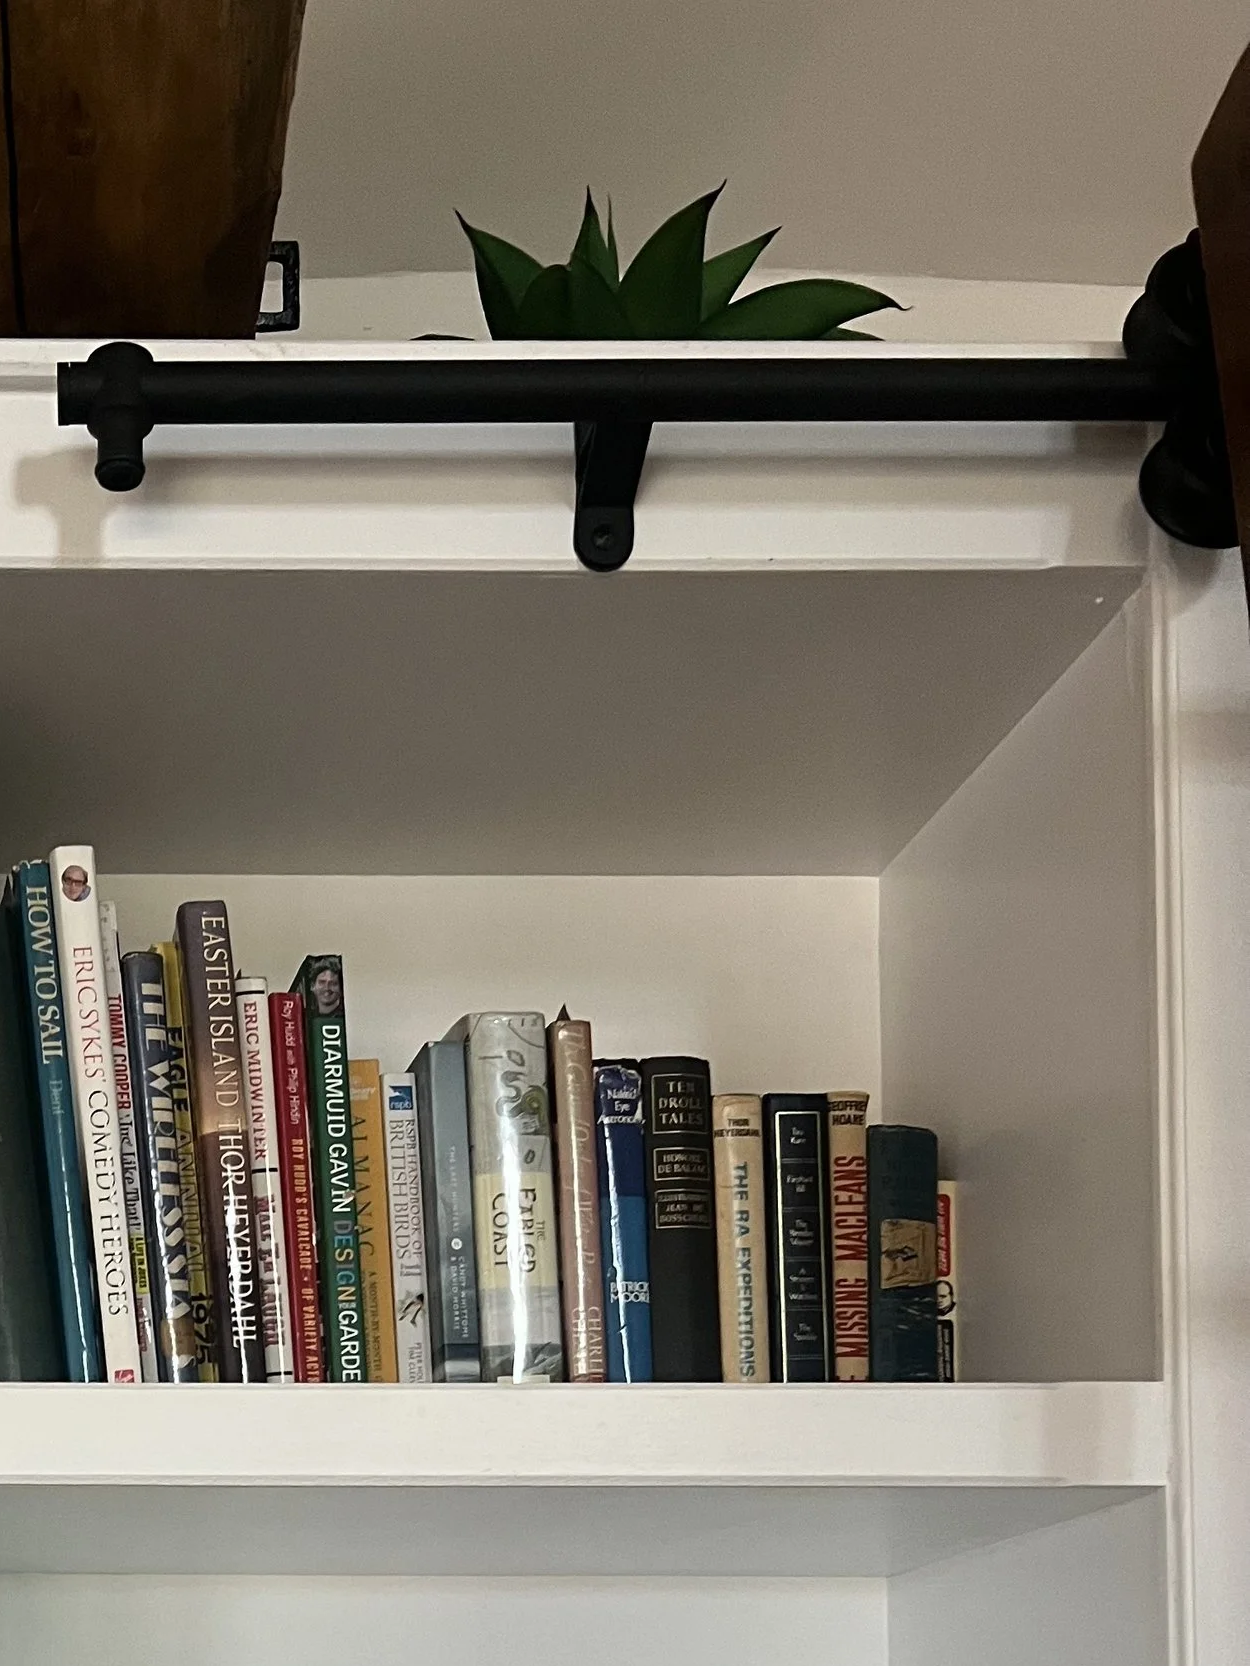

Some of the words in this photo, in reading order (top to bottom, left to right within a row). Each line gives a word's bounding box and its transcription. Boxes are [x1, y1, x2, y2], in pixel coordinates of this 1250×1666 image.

[25, 885, 54, 956] HOW
[33, 960, 58, 1001] TO
[73, 945, 97, 1005] ERIC
[200, 916, 232, 1010] EASTER
[37, 1004, 64, 1065] SAIL
[107, 993, 128, 1049] TOMMY
[141, 982, 168, 1051] THE
[243, 1001, 260, 1046] ERIC
[280, 1000, 294, 1018] Roy
[284, 1021, 297, 1047] Hudd
[78, 1008, 107, 1084] SYKES'
[167, 1026, 189, 1112] EAGLE
[209, 1015, 240, 1107] ISLAND
[49, 1079, 65, 1116] Dent
[113, 1053, 132, 1111] COOPER
[247, 1048, 268, 1162] MIDWINTER
[321, 1024, 347, 1138] DIARMUID
[614, 1101, 631, 1113] Eye
[658, 1096, 701, 1110] DROLL
[666, 1080, 695, 1093] TEN
[87, 1090, 118, 1203] COMEDY
[404, 1119, 416, 1150] RSPB
[658, 1112, 704, 1125] TALES
[727, 1117, 750, 1128] THOR
[831, 1114, 865, 1126] HOARE
[122, 1150, 139, 1185] Like
[147, 1058, 187, 1249] WIRELESS
[217, 1118, 246, 1191] THOR
[291, 1138, 304, 1160] ROY
[328, 1142, 355, 1213] GAVIN
[389, 1119, 409, 1197] BRITISH
[657, 1164, 672, 1174] DE
[174, 1130, 204, 1273] ANNUAL
[293, 1164, 308, 1204] HUDD'S
[407, 1152, 423, 1234] HANDBOOK
[733, 1161, 749, 1202] THE
[833, 1155, 868, 1262] MACLEANS
[295, 1208, 313, 1270] CAVALCADE
[393, 1202, 412, 1260] BIRDS
[412, 1236, 424, 1258] OF
[491, 1192, 511, 1267] COAST
[734, 1209, 751, 1238] RA
[100, 1212, 129, 1318] HEROES
[223, 1195, 258, 1350] HEYERDAHL
[333, 1219, 357, 1301] DESIGN
[301, 1288, 315, 1302] OF
[735, 1246, 757, 1379] EXPEDITIONS
[835, 1275, 869, 1360] MISSING
[302, 1305, 318, 1352] VARIETY
[305, 1356, 320, 1383] ACTS
